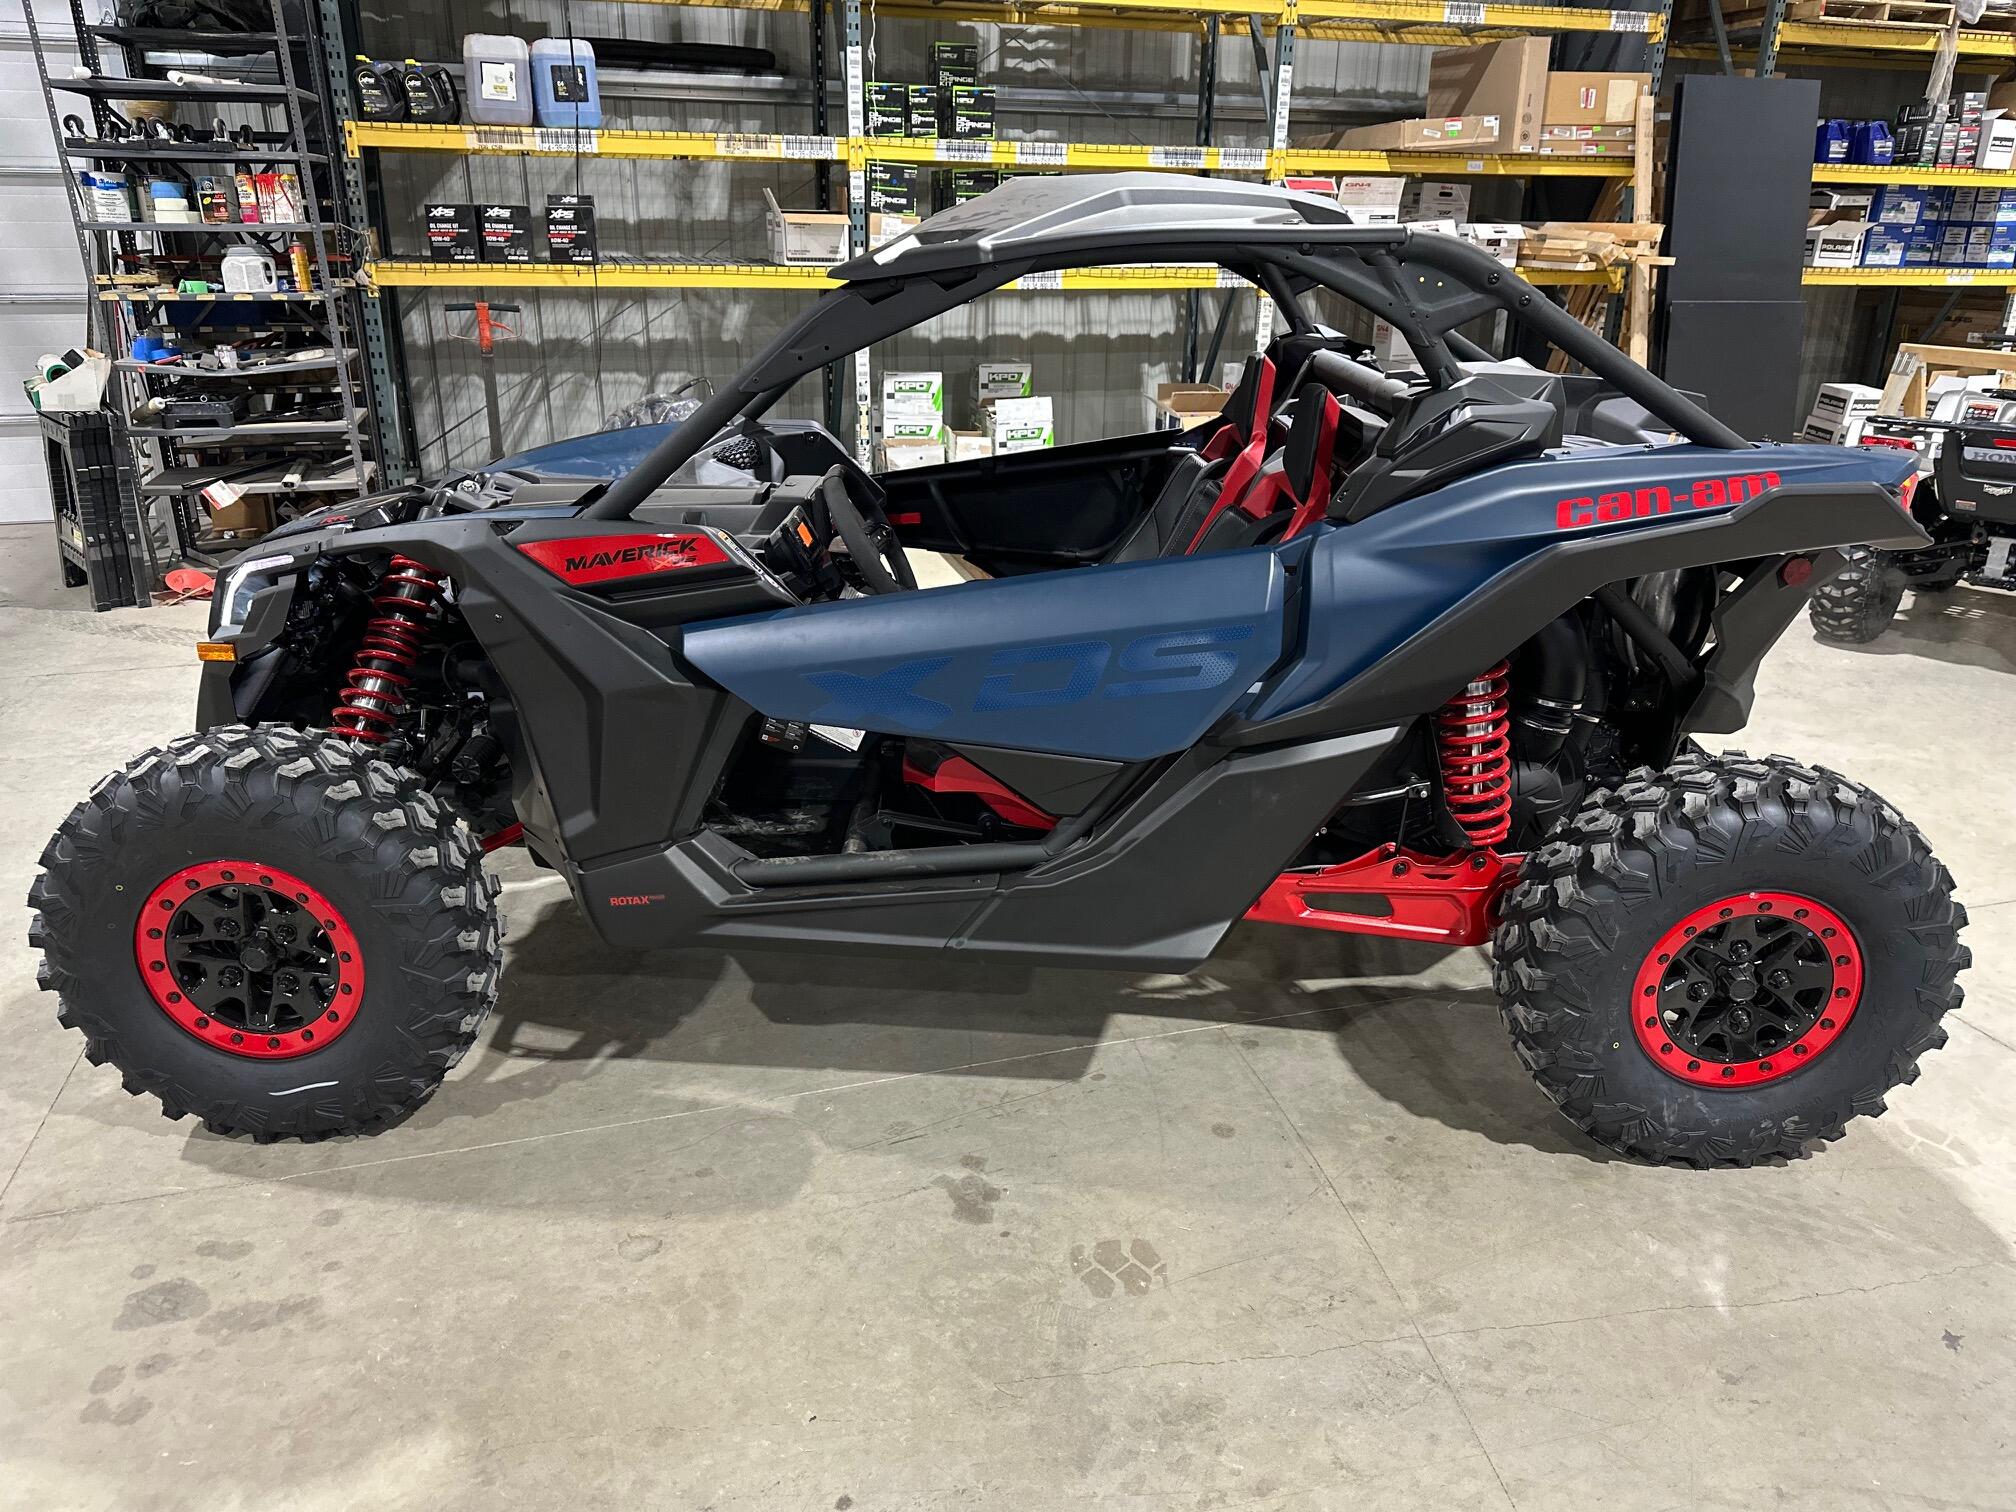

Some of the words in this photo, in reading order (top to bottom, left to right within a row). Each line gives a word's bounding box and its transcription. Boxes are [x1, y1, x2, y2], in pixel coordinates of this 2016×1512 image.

[956, 121, 991, 129] CHANGE
[871, 196, 907, 205] CHANGE
[429, 207, 455, 217] XPS
[485, 206, 511, 217] XPS
[549, 209, 575, 218] XPS
[1556, 471, 1781, 528] can-am
[565, 537, 699, 573] MAVERICK
[609, 895, 650, 906] ROTAX
